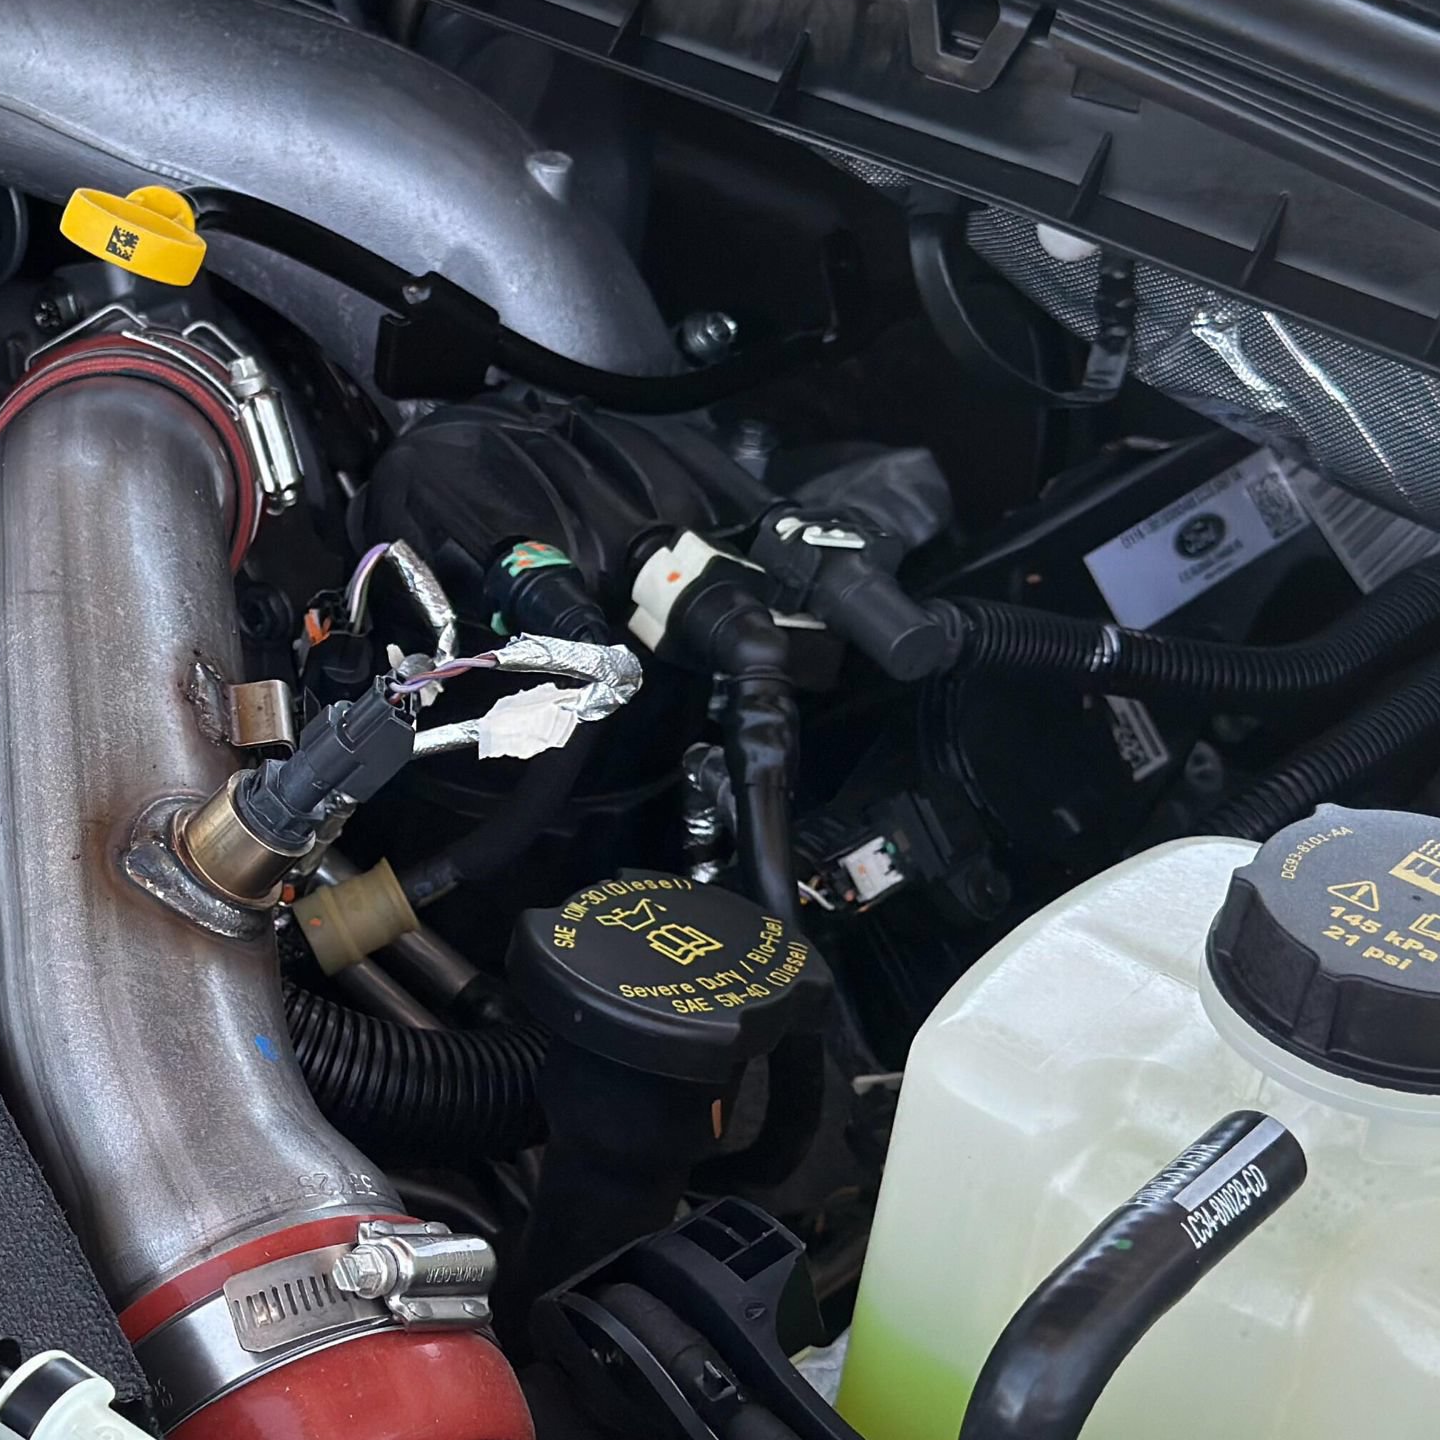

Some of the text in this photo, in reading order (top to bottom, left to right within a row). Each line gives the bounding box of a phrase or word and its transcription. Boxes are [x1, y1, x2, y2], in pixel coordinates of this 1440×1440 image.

[1281, 826, 1353, 879] DG93-8101-AA
[554, 879, 692, 948] SAE 10W-30 (Diesel)
[1322, 925, 1412, 970] 21 psi
[1330, 906, 1438, 962] 145 kPa
[619, 982, 695, 998] Severe
[696, 969, 747, 990] Duty
[747, 916, 784, 964] Bio-Fuel
[672, 941, 809, 1014] SAE 5W-40 (Diesel)
[1180, 1163, 1267, 1249] LC34-8N029-CD
